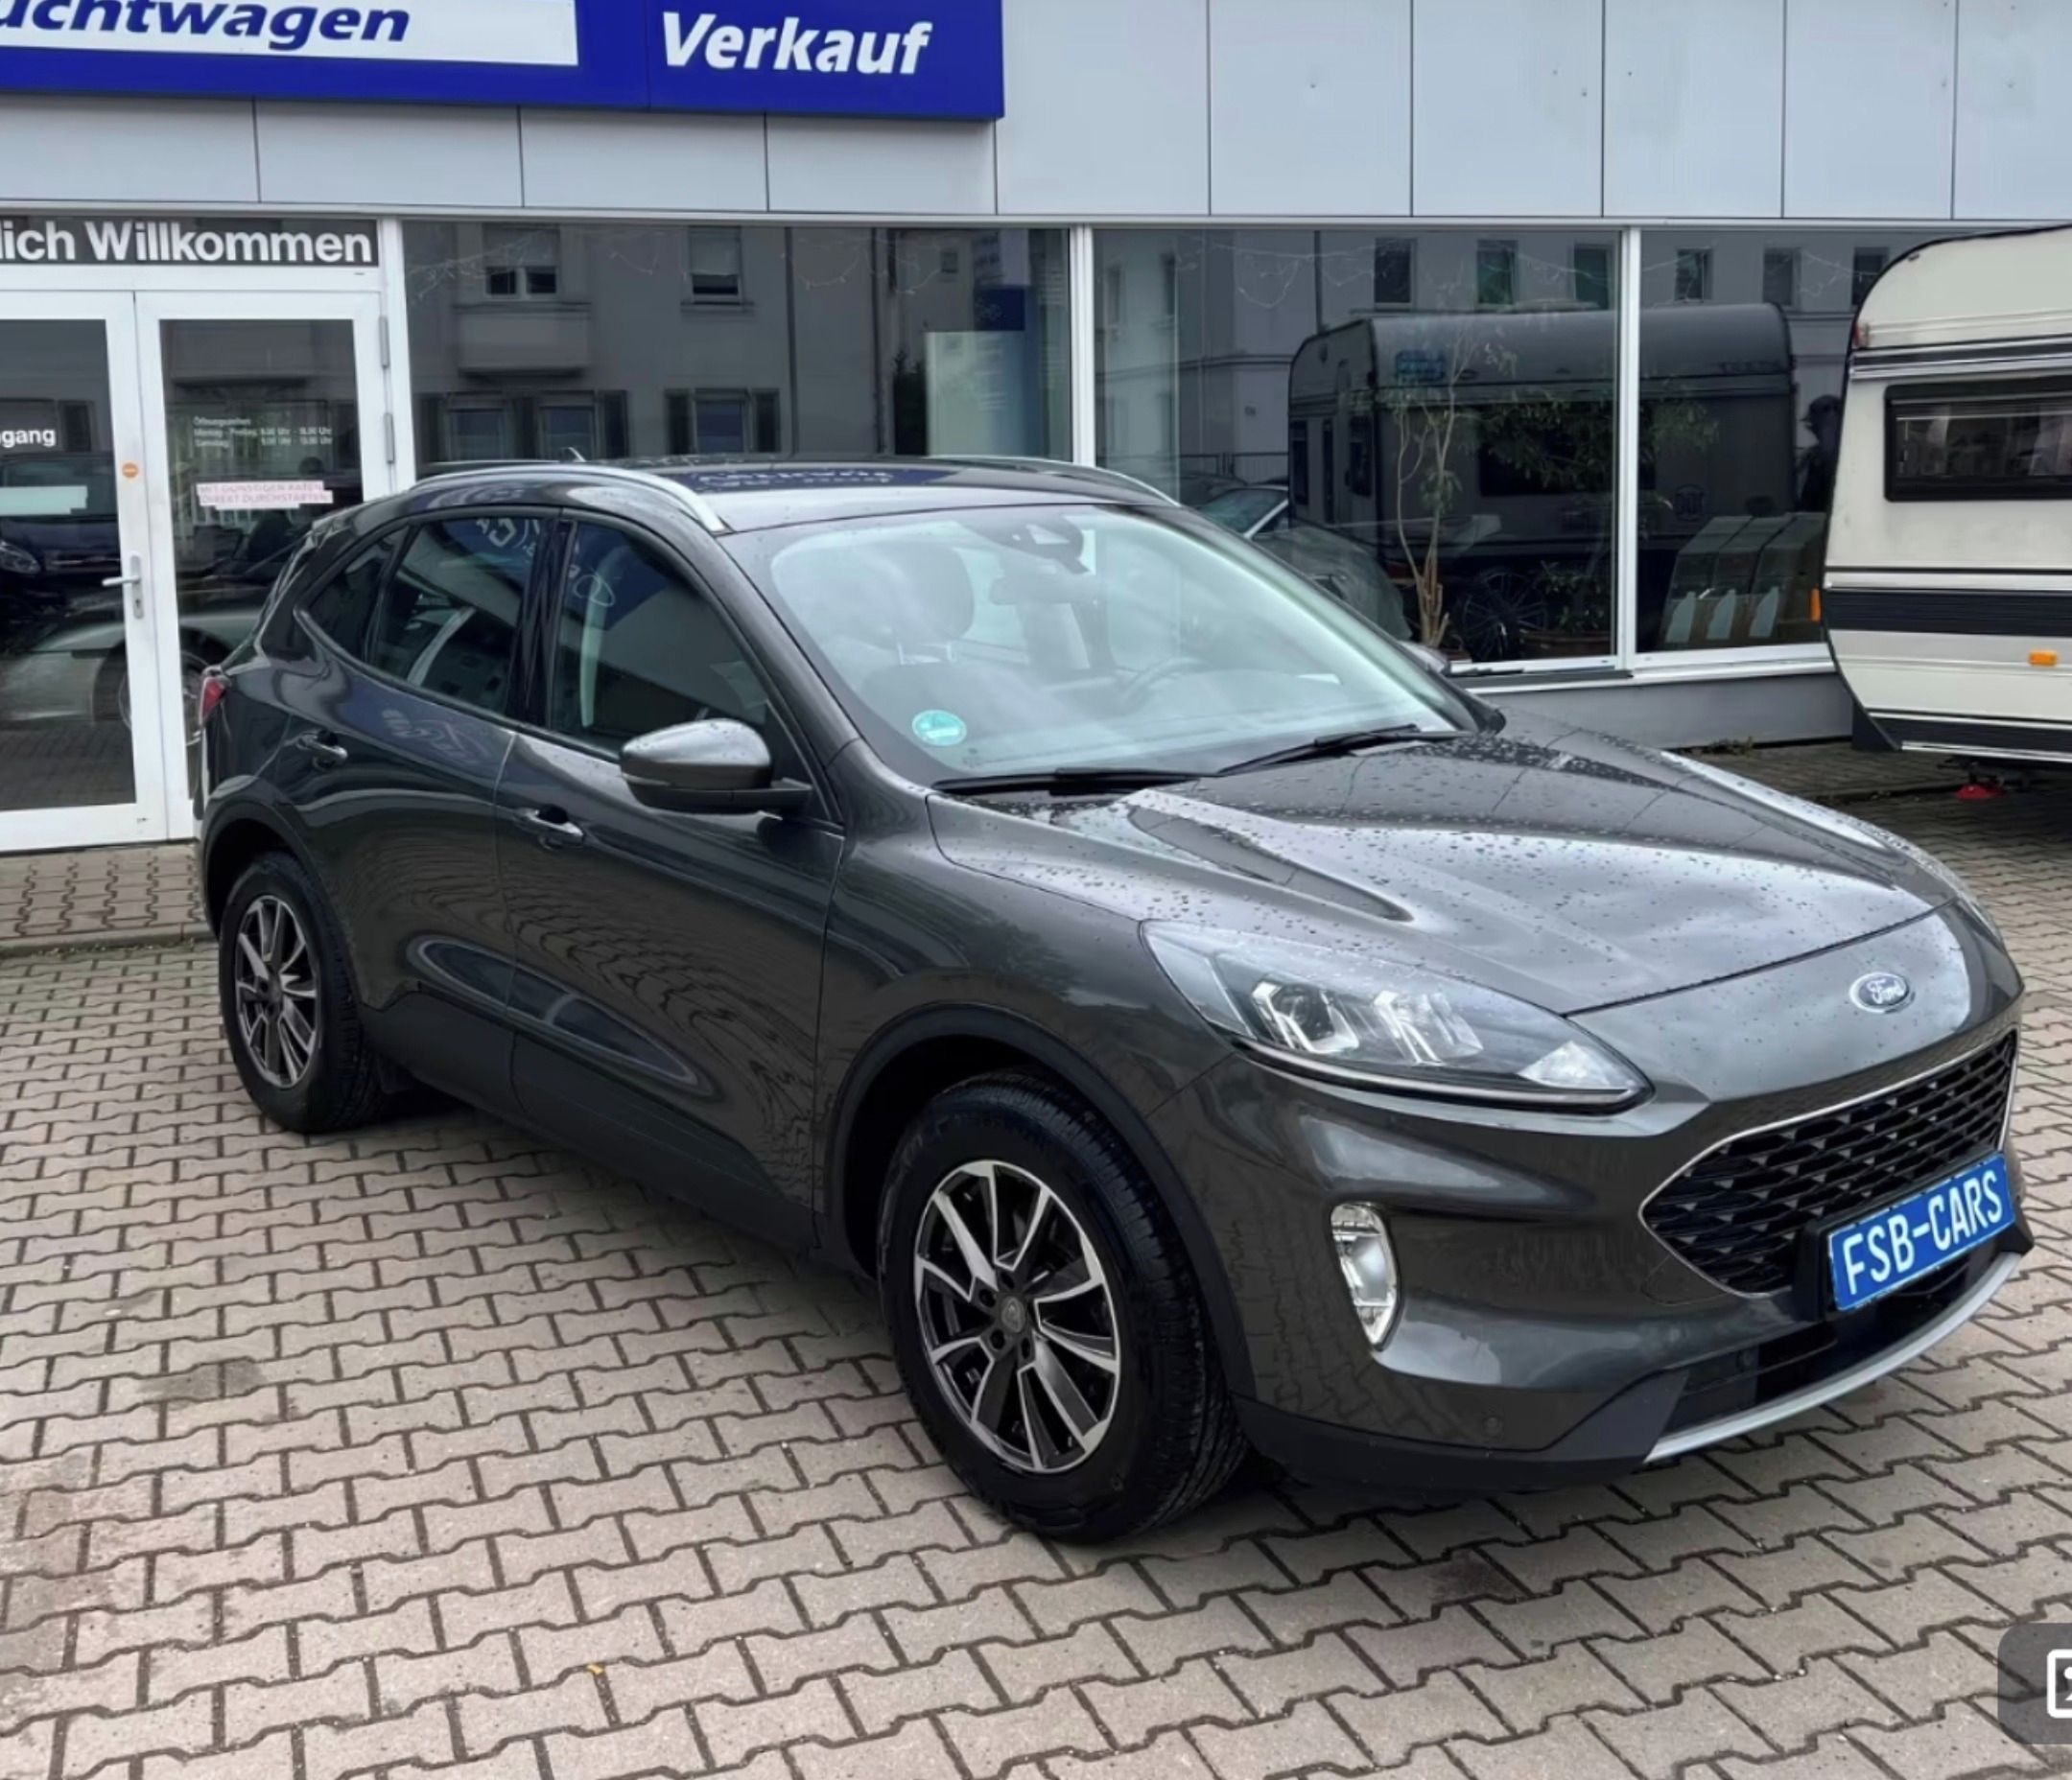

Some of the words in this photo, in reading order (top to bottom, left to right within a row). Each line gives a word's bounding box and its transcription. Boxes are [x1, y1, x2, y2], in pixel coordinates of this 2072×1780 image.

[663, 12, 933, 74] Verkauf
[83, 221, 372, 263] Willkommen
[0, 429, 57, 448] gang
[1867, 978, 1906, 1004] Ford
[1842, 1169, 2004, 1295] FSB-CARS
